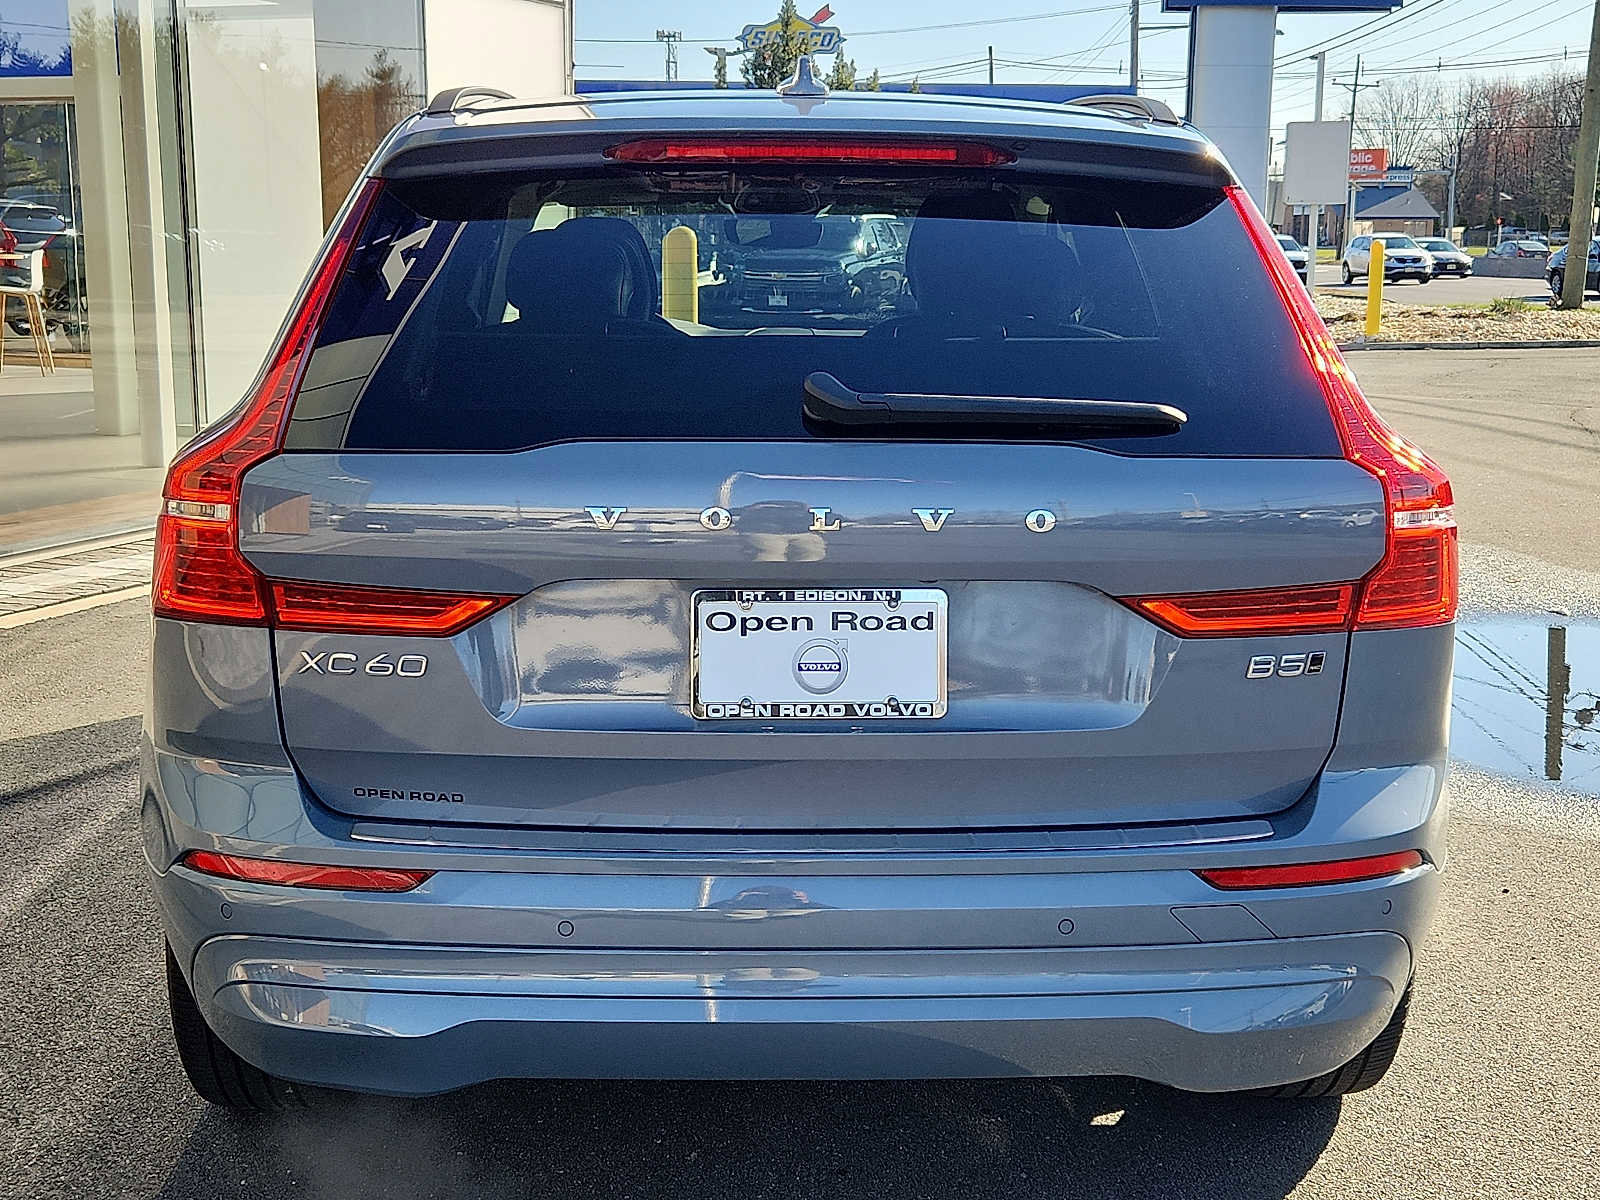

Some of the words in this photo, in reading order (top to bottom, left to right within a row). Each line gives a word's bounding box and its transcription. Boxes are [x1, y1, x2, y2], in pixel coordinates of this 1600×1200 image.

[1350, 151, 1373, 163] blic
[1349, 165, 1377, 177] rage
[584, 506, 1058, 533] VOLVO
[778, 590, 787, 601] 1
[705, 611, 814, 637] Open
[831, 611, 935, 631] Road
[799, 663, 841, 671] VOLVO
[707, 704, 772, 718] OPEN
[779, 704, 846, 717] ROAD
[853, 703, 932, 717] VOLVO
[353, 787, 405, 800] OPEN
[409, 790, 464, 803] ROAD
